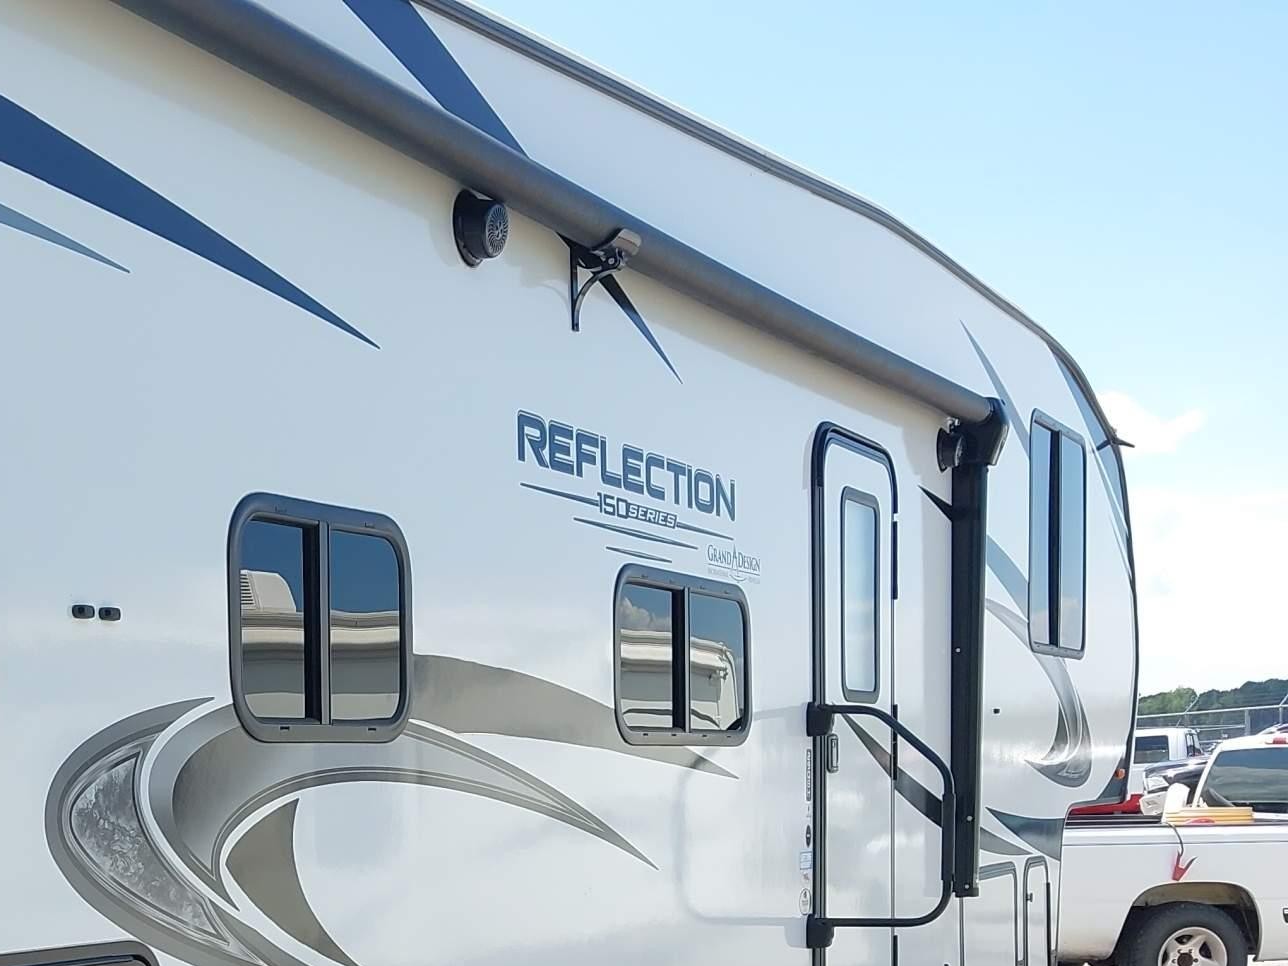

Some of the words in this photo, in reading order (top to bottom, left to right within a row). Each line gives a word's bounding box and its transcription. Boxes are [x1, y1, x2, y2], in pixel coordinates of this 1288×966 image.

[516, 408, 736, 522] REFLECTION
[597, 491, 628, 519] 150
[628, 504, 676, 528] SERIES
[707, 544, 732, 566] GRAND
[738, 551, 761, 573] DESIGN
